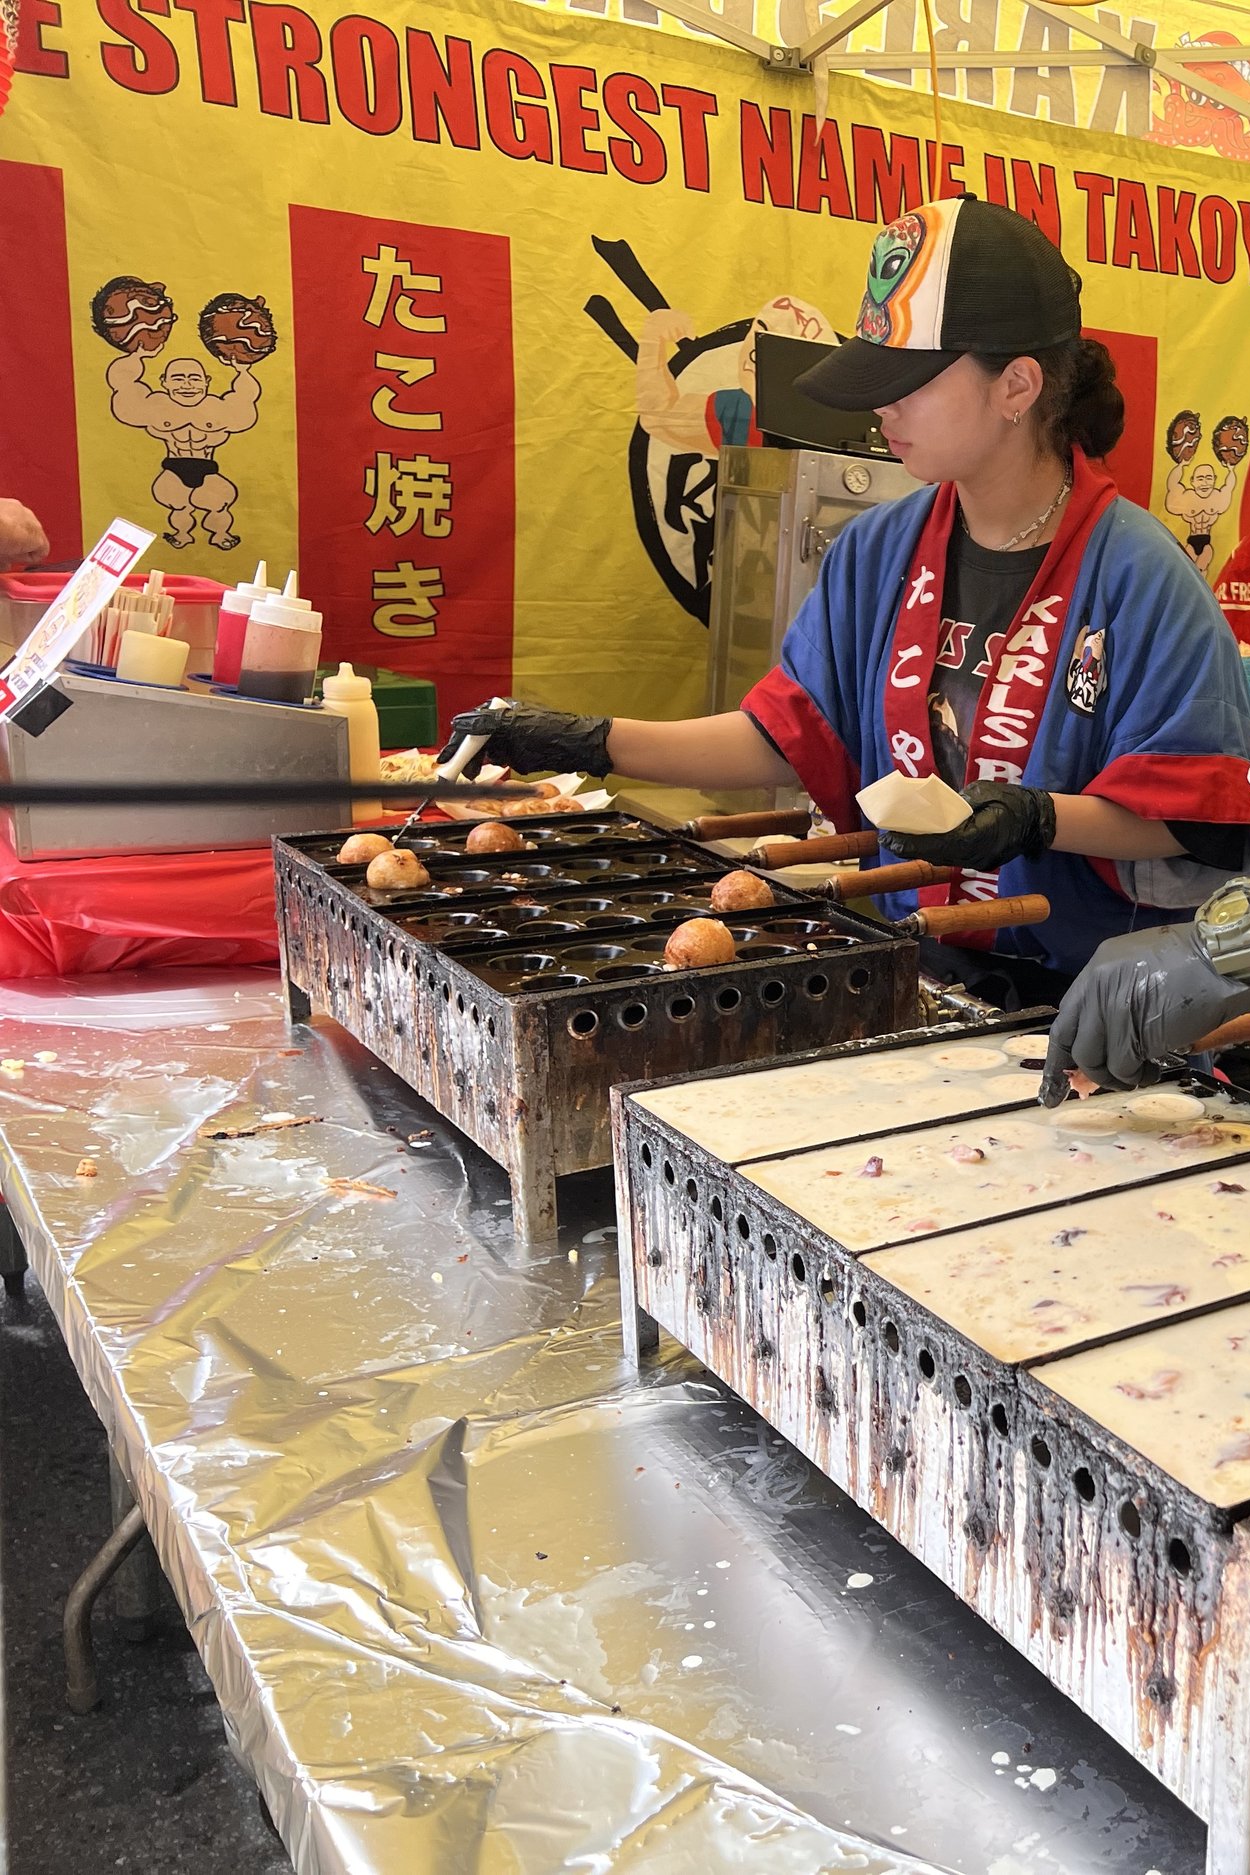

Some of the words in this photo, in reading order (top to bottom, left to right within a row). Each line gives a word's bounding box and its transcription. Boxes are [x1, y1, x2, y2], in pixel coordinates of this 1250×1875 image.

[97, 0, 718, 193] STRONGEST
[362, 242, 453, 639] たこ焼き
[979, 595, 1063, 749] KARLS
